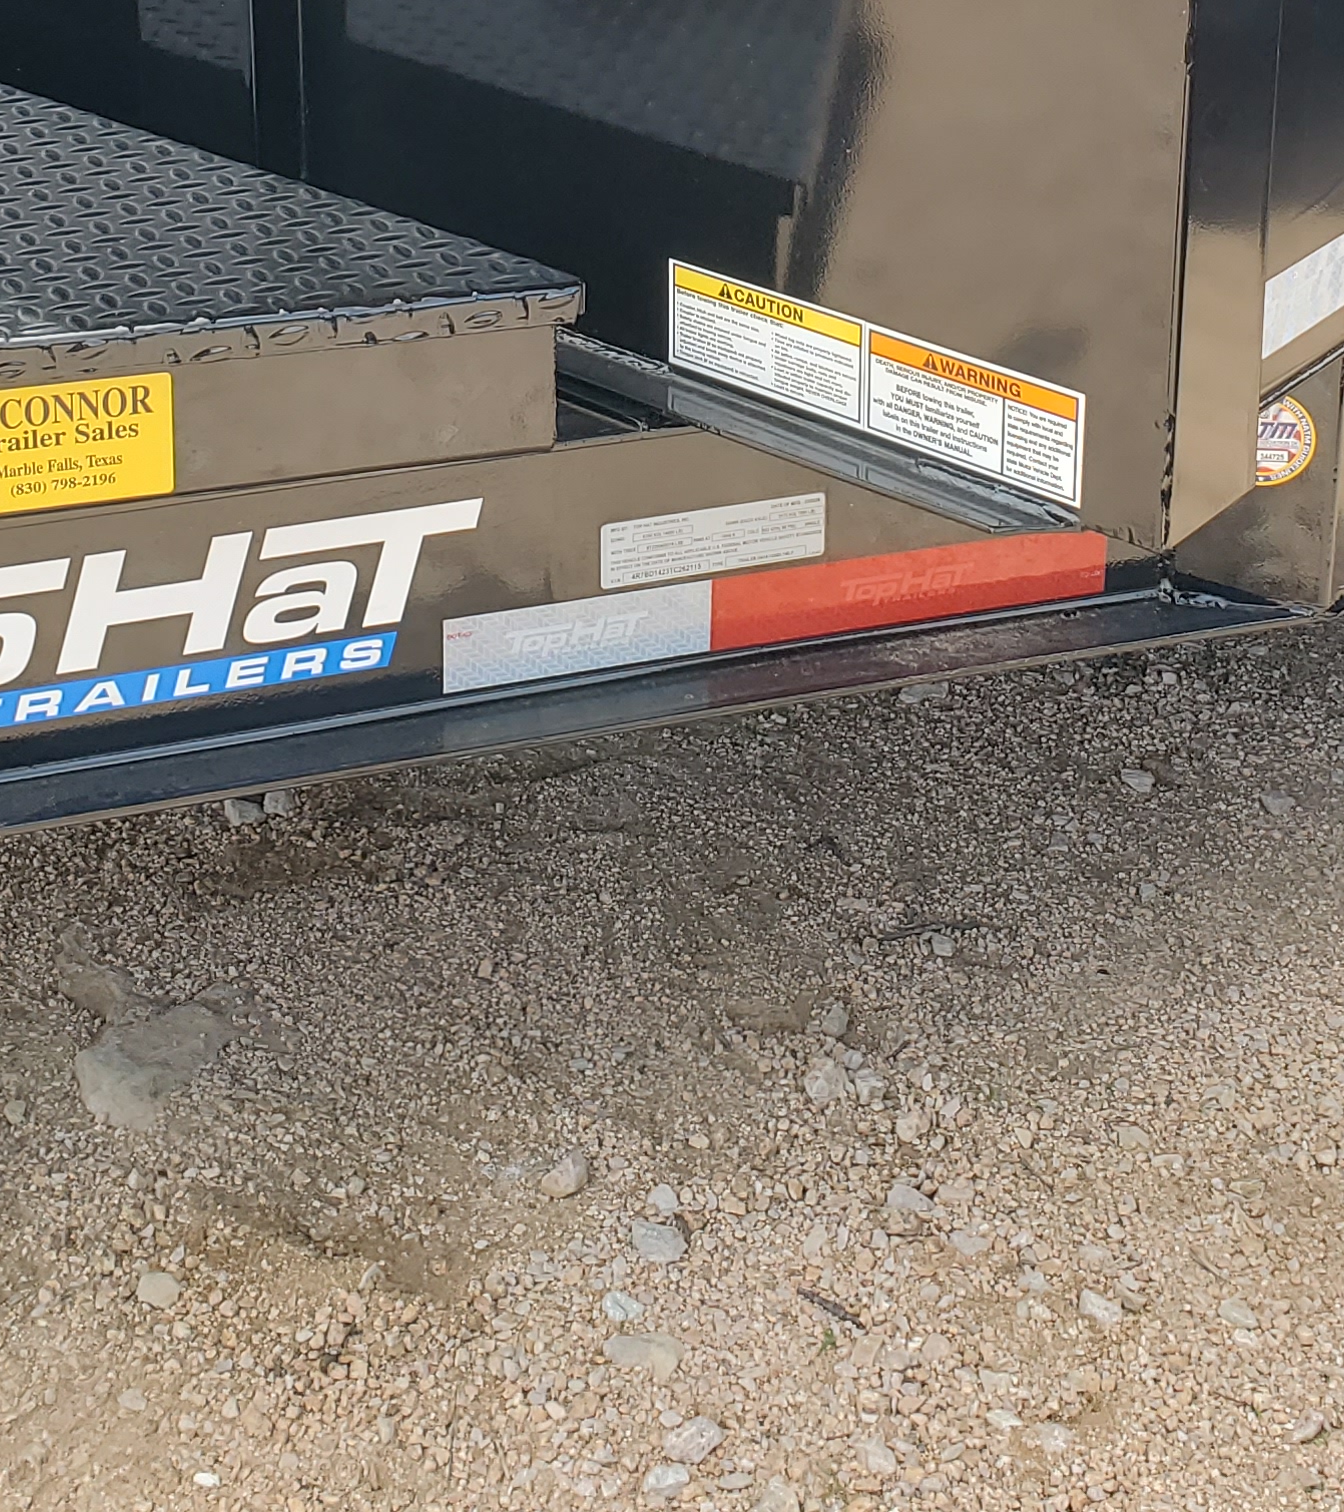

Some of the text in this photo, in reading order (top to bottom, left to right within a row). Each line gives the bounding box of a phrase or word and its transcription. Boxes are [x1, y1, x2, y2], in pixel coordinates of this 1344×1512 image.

[734, 289, 803, 323] CAUTION
[940, 358, 1022, 398] WARNING
[891, 392, 904, 403] YOU
[905, 397, 923, 409] MUST
[896, 383, 920, 399] BEFORE
[75, 421, 139, 445] Sales
[969, 429, 998, 445] CAUTION
[48, 457, 83, 474] Falls,
[86, 454, 123, 470] Texas
[10, 472, 117, 498] (830) 798-2196
